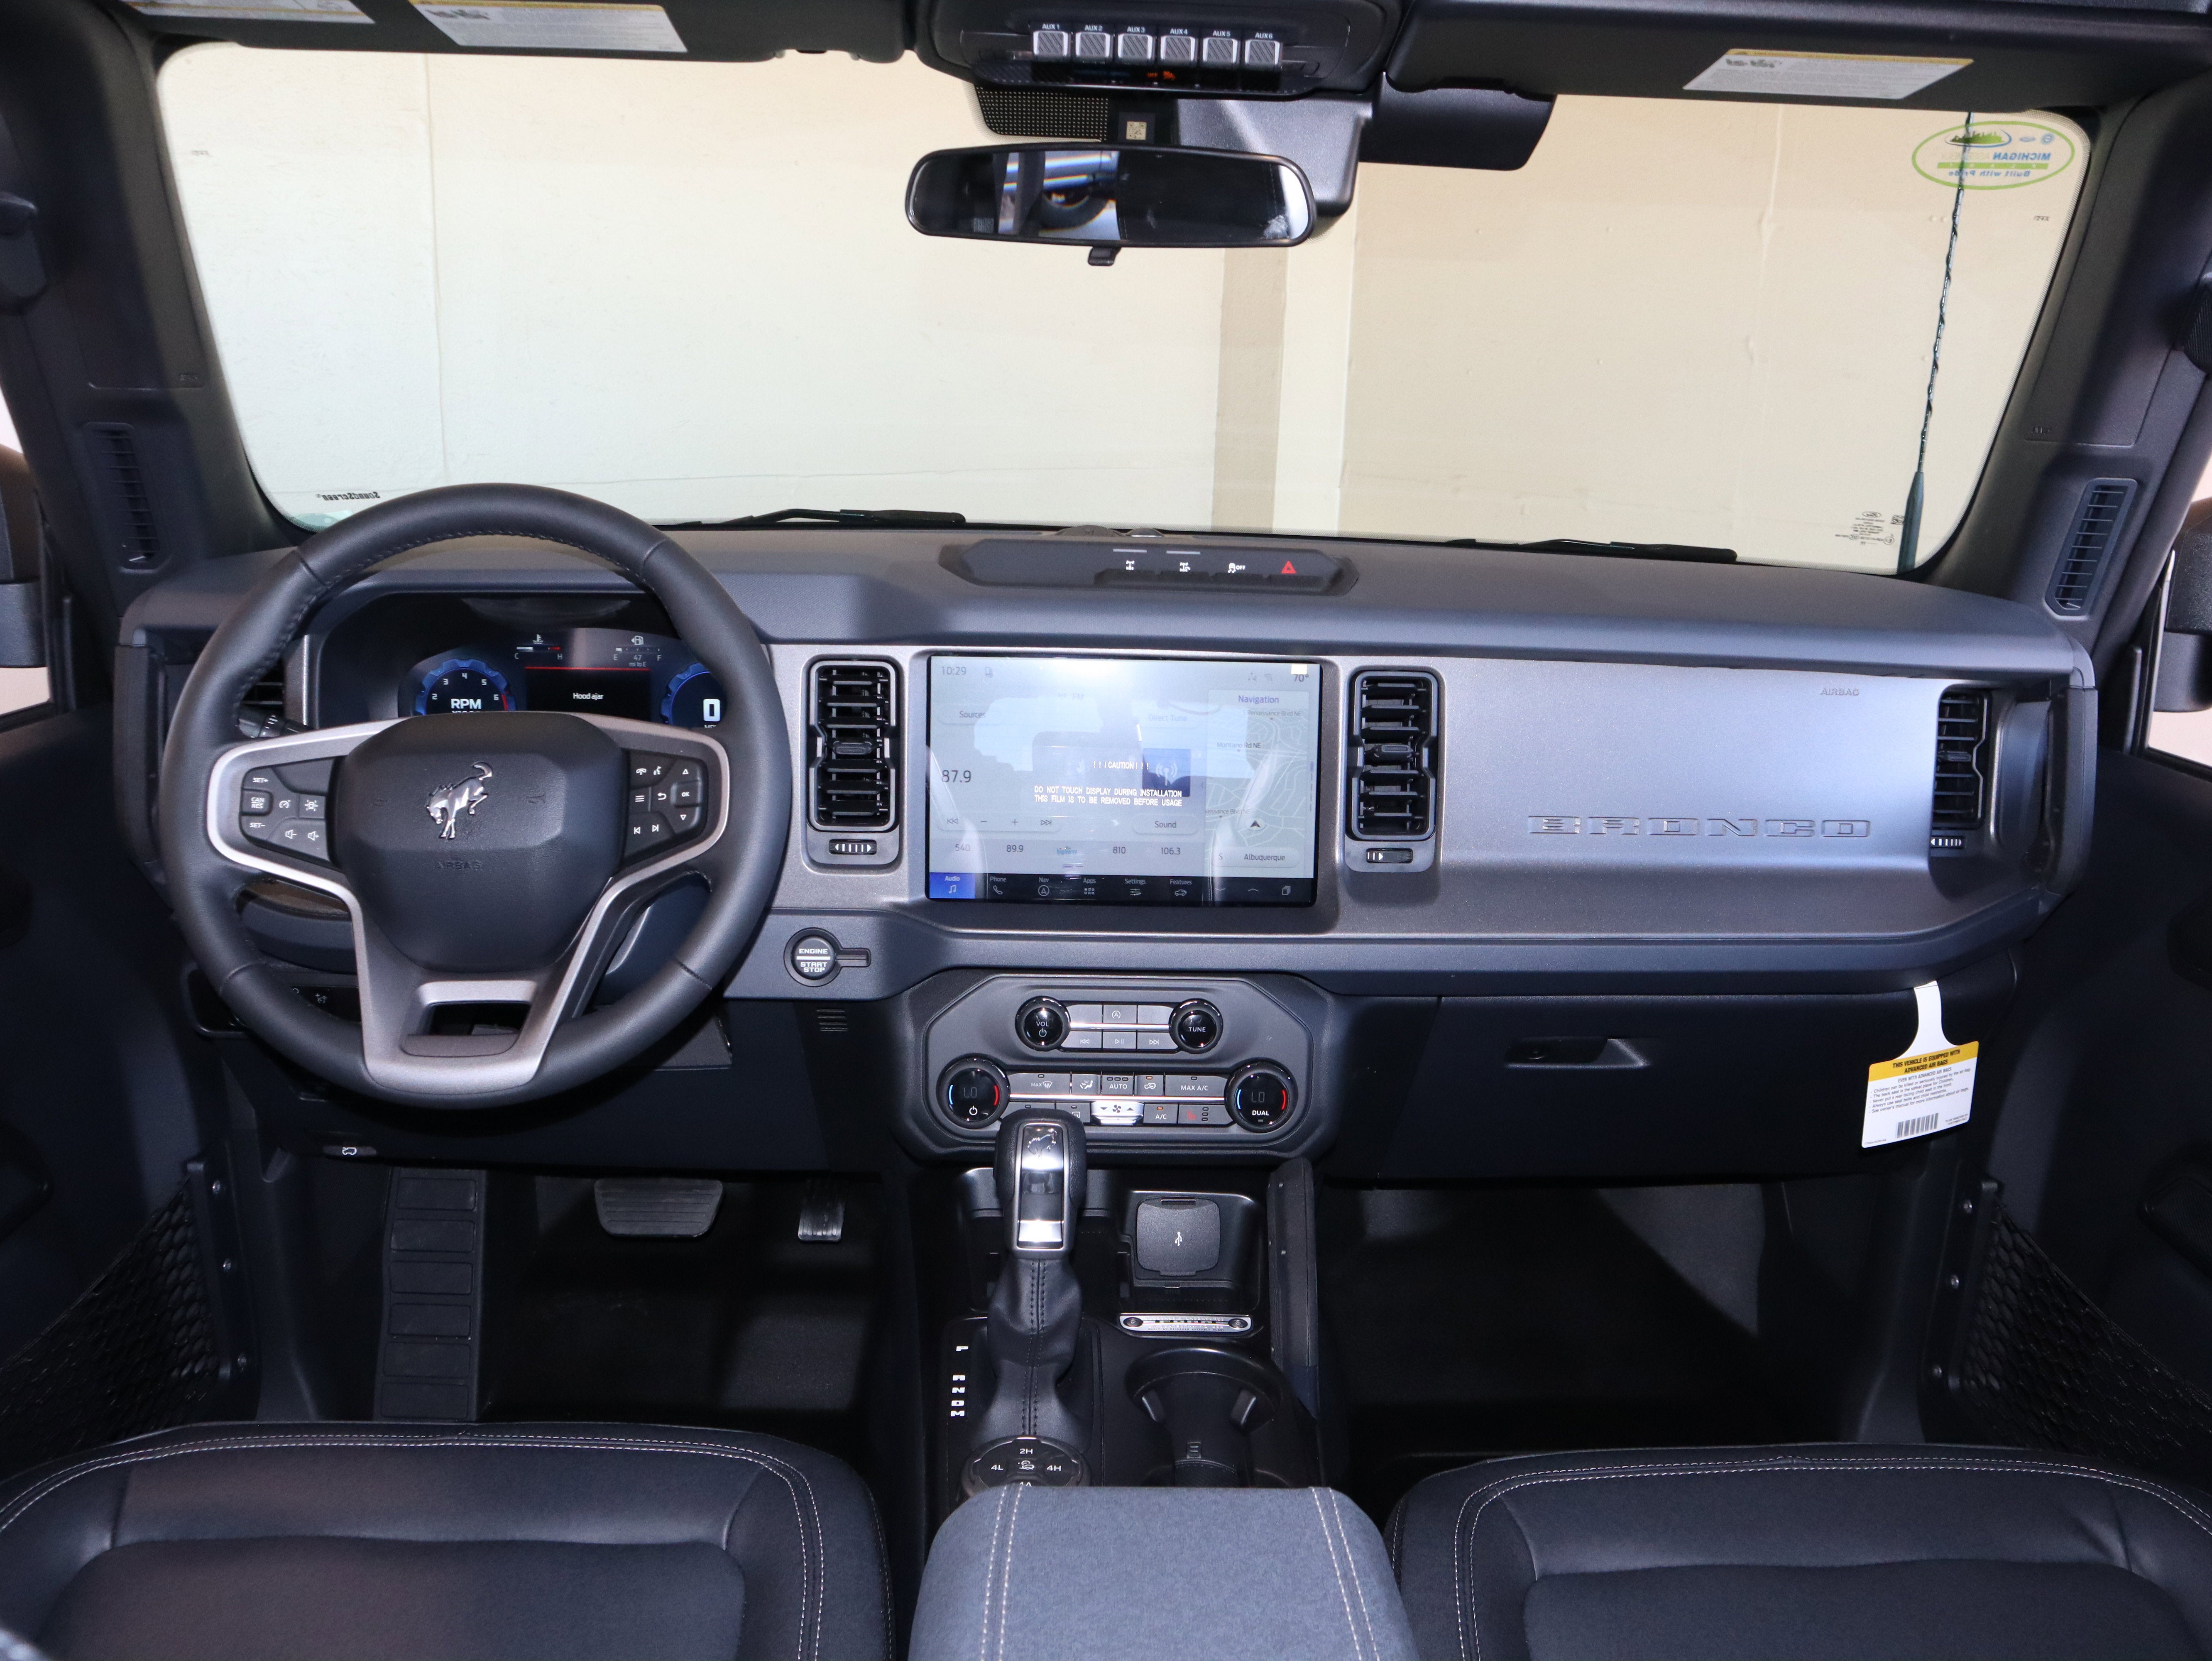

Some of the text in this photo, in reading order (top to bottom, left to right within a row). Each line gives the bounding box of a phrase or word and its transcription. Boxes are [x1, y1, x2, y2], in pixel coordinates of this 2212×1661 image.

[941, 666, 967, 675] 10:29
[451, 698, 482, 709] RPM
[1238, 695, 1279, 704] Navigation
[703, 699, 720, 722] 0
[942, 770, 971, 783] 87.9
[1140, 789, 1182, 797] INSTALLATION
[1101, 796, 1130, 805] REMOVED
[1527, 815, 1871, 838] BRONCO
[1244, 854, 1285, 862] Albuquerque
[1928, 1052, 1949, 1061] EQUIPPED
[1904, 1064, 1928, 1073] ADVANCED
